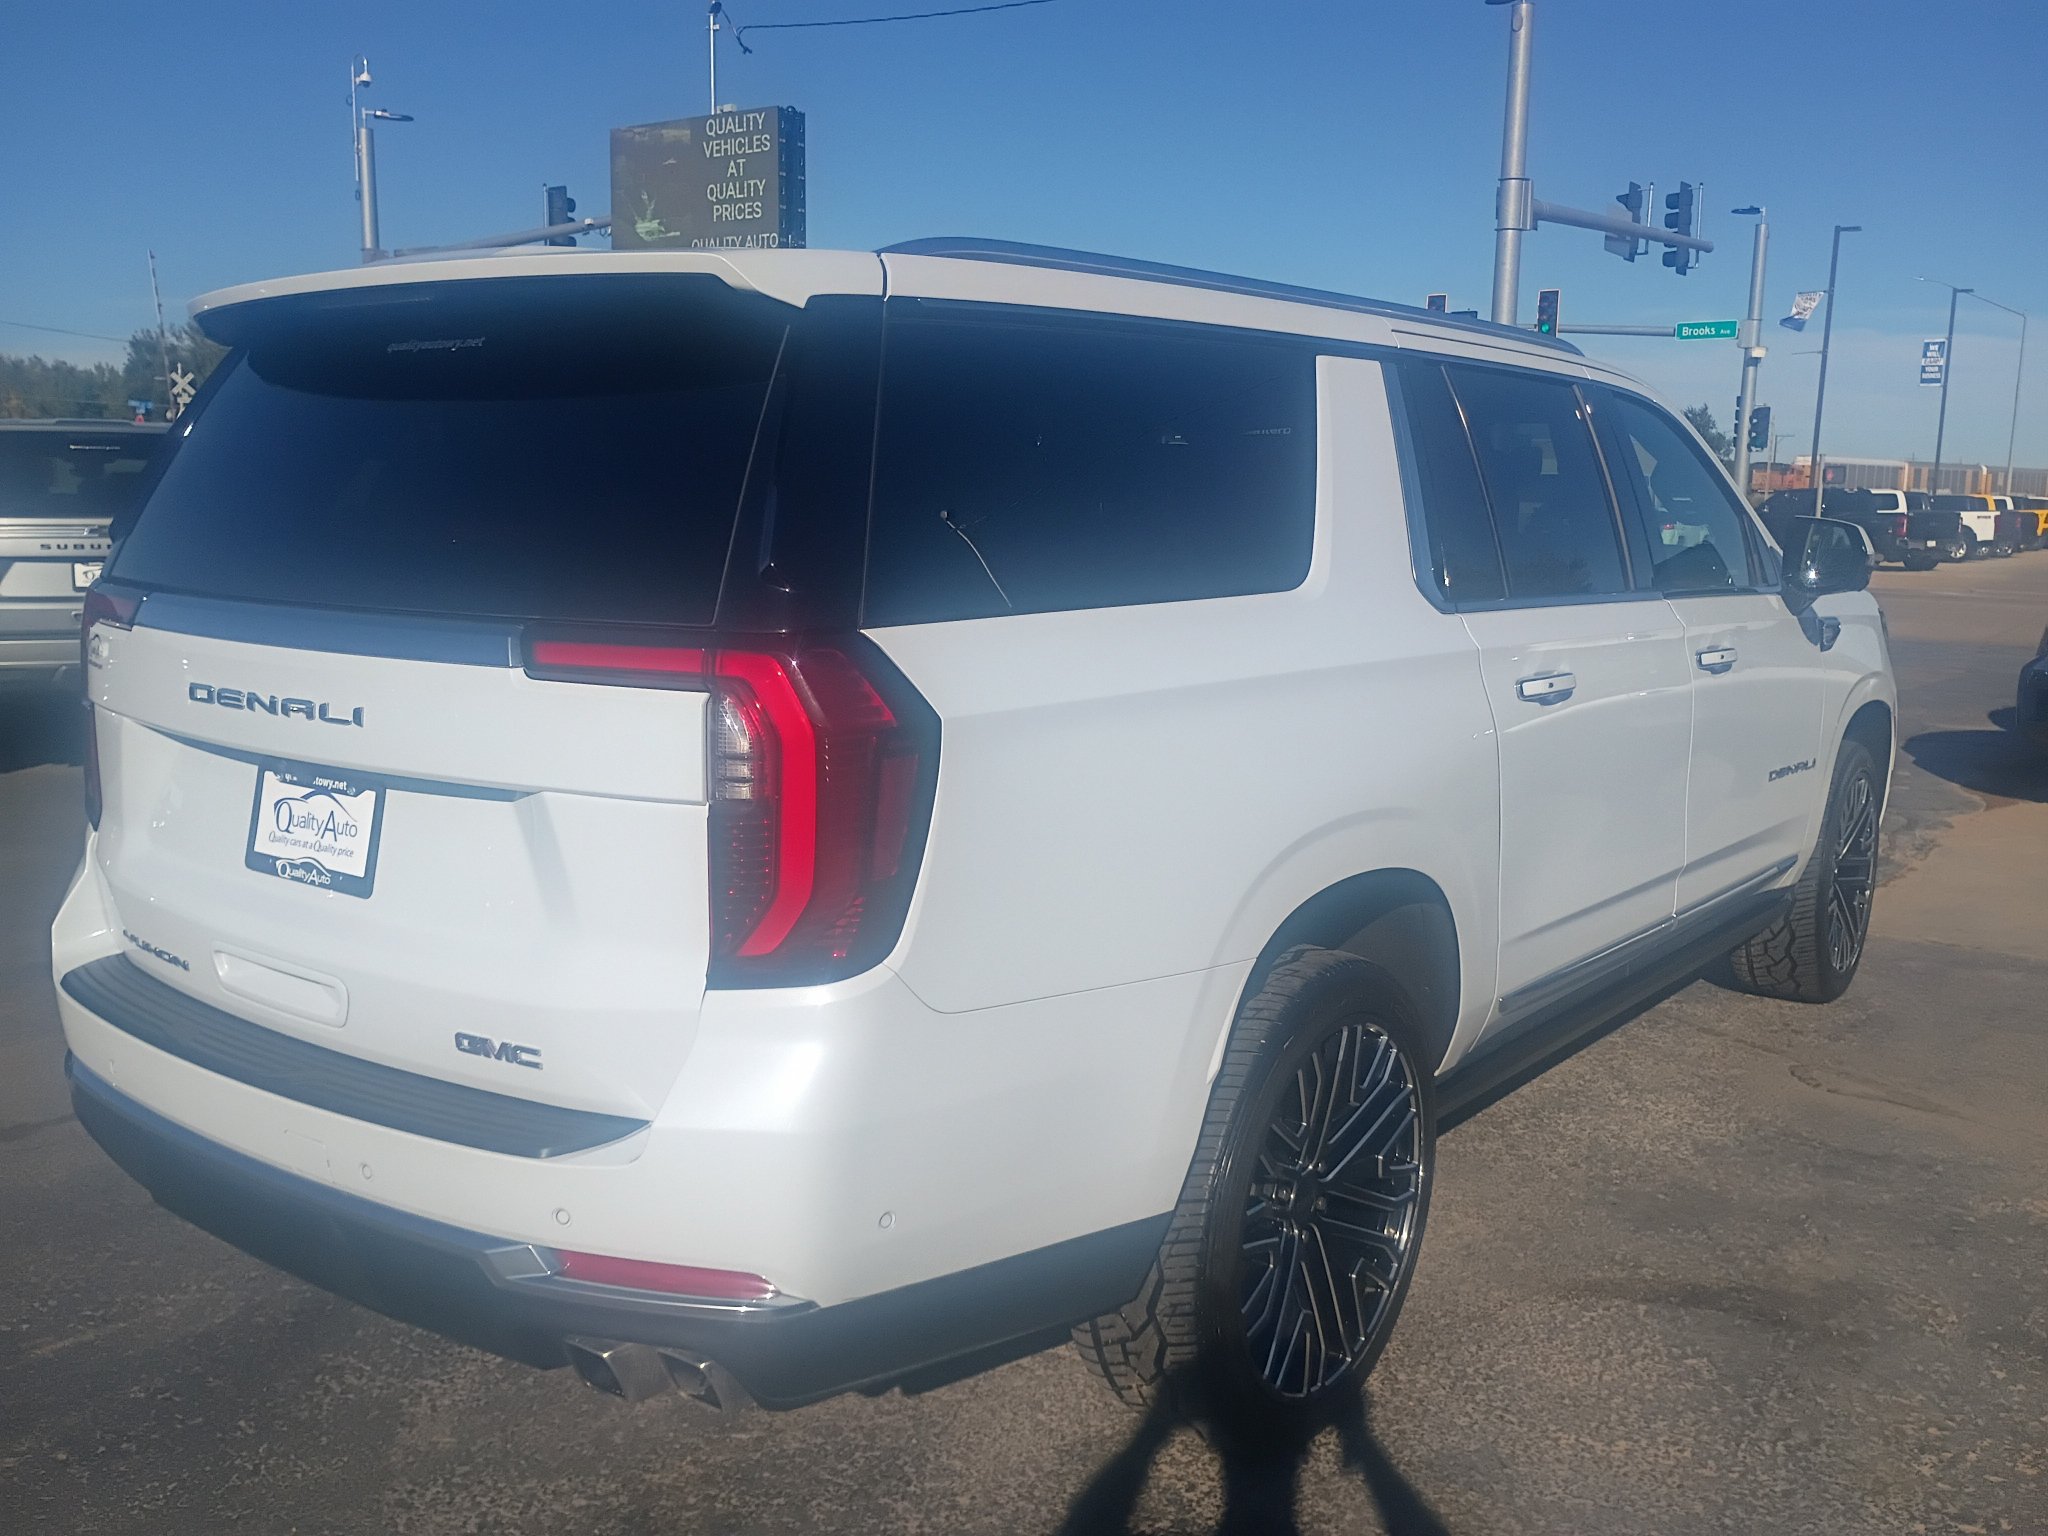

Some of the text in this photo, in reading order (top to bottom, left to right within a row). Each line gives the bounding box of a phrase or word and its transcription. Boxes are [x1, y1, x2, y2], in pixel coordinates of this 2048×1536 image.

[705, 112, 765, 137] QUALITY
[703, 134, 771, 158] VEHICLES
[727, 159, 746, 177] AT
[706, 179, 766, 202] QUALITY
[713, 202, 762, 222] PRICES
[746, 233, 778, 248] AUTO
[1682, 325, 1716, 336] Brooks
[188, 682, 365, 728] DENALI
[1768, 757, 1816, 782] DENALI
[268, 830, 290, 847] Quality
[290, 838, 301, 848] cars
[313, 840, 338, 856] Quality
[337, 848, 354, 858] price
[455, 1031, 543, 1070] GMC
